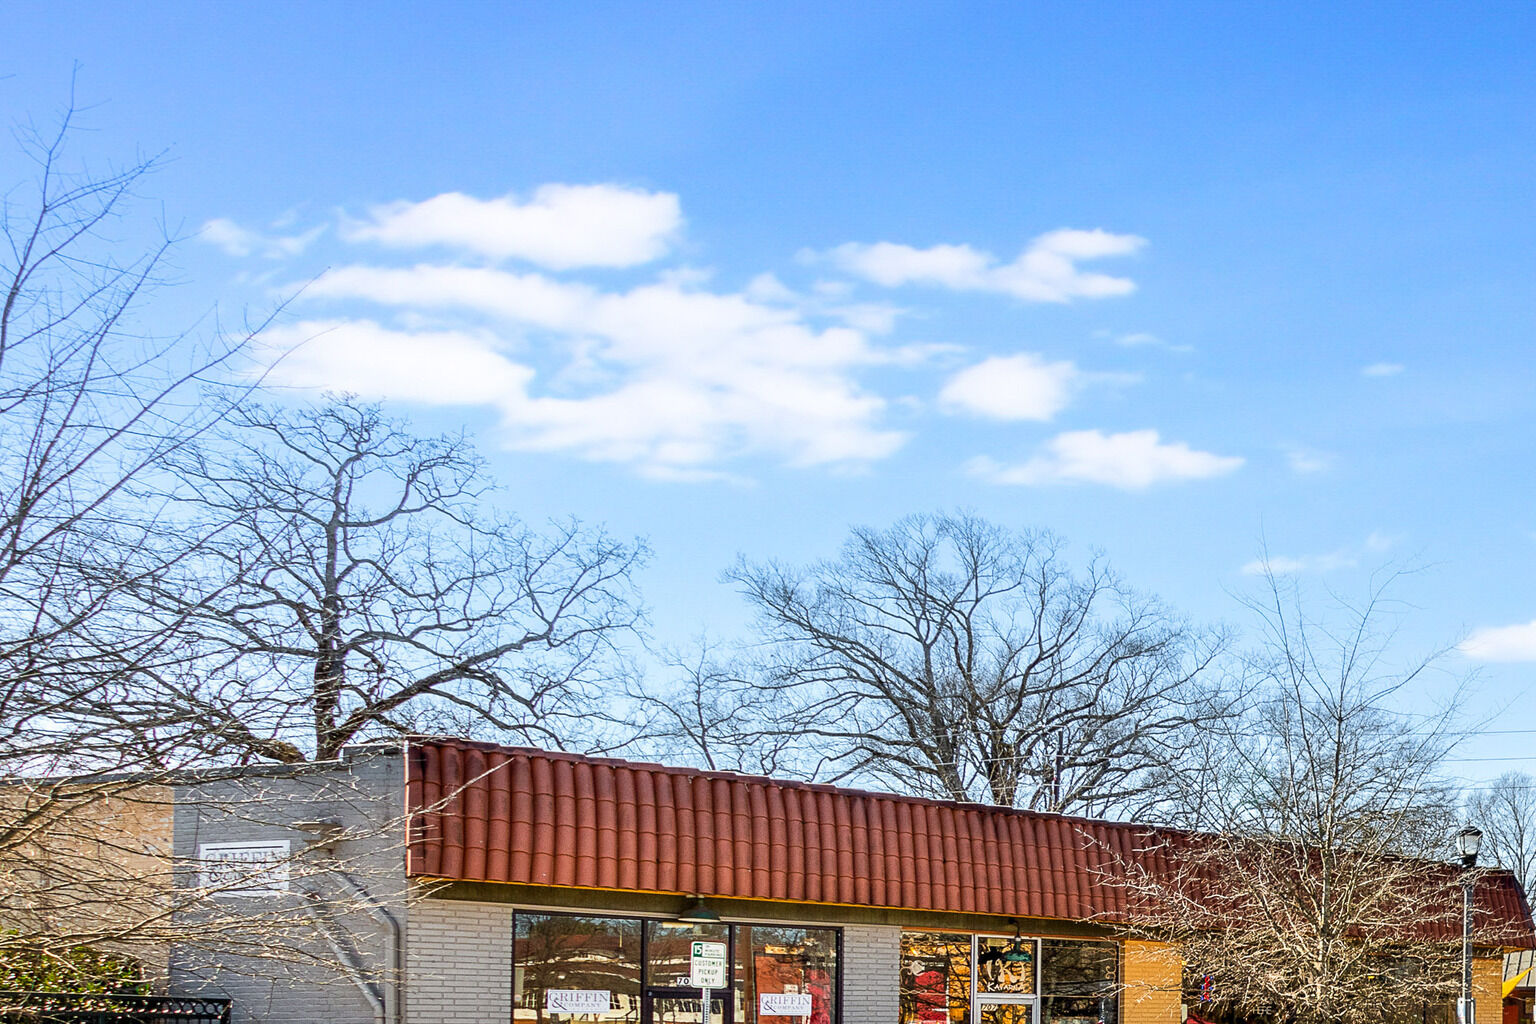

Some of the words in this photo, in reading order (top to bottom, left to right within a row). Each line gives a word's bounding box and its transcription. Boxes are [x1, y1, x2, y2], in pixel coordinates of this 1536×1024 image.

[694, 945, 703, 955] 15
[694, 959, 722, 967] CUSTOMER
[698, 968, 718, 976] PICKUP
[700, 977, 716, 985] ONLY
[549, 992, 609, 1002] GRIFFIN
[761, 996, 810, 1005] GRIFFIN
[551, 997, 568, 1011] &
[763, 1000, 777, 1013] &
